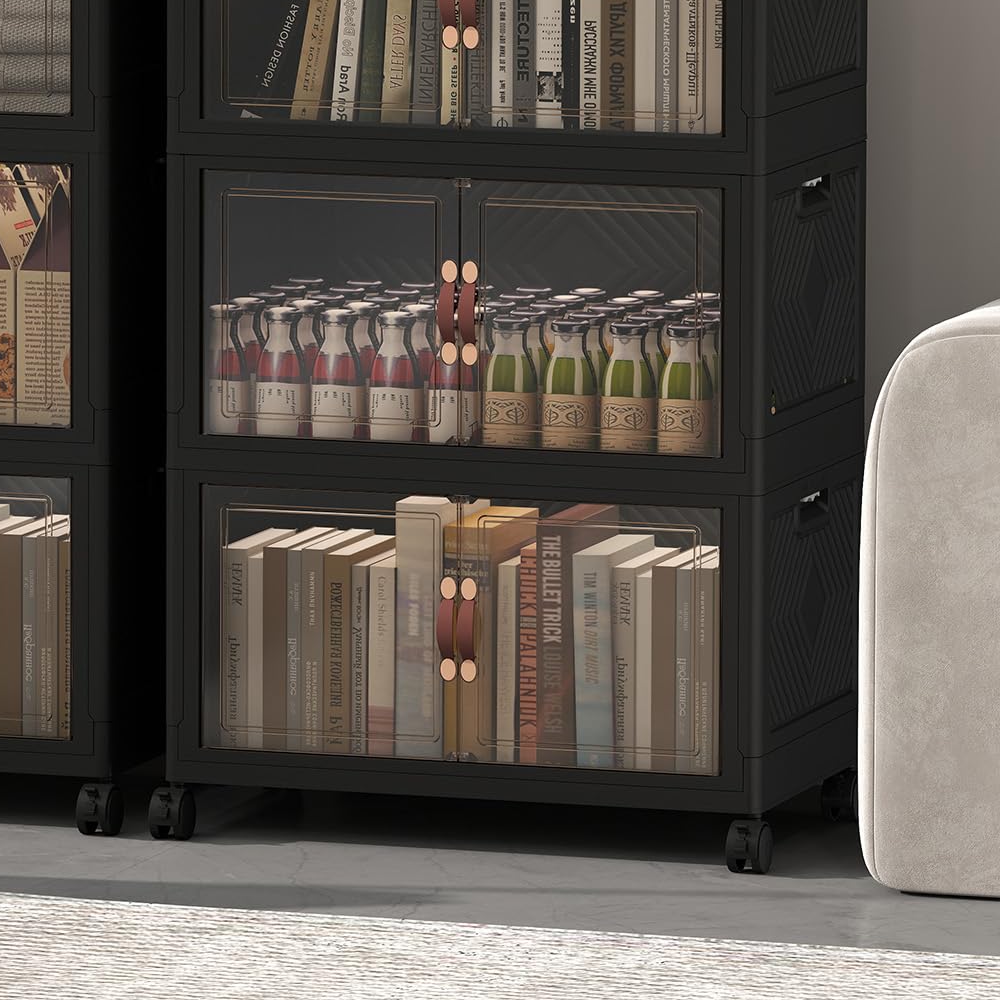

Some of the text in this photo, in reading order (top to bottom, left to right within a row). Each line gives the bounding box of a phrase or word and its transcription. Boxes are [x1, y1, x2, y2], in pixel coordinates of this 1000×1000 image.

[377, 576, 387, 636] Carol Shields
[542, 536, 562, 733] THE BULLET TRICK LOUISE WELSH
[584, 572, 598, 684] TIM WINTON DIRT MUSIC
